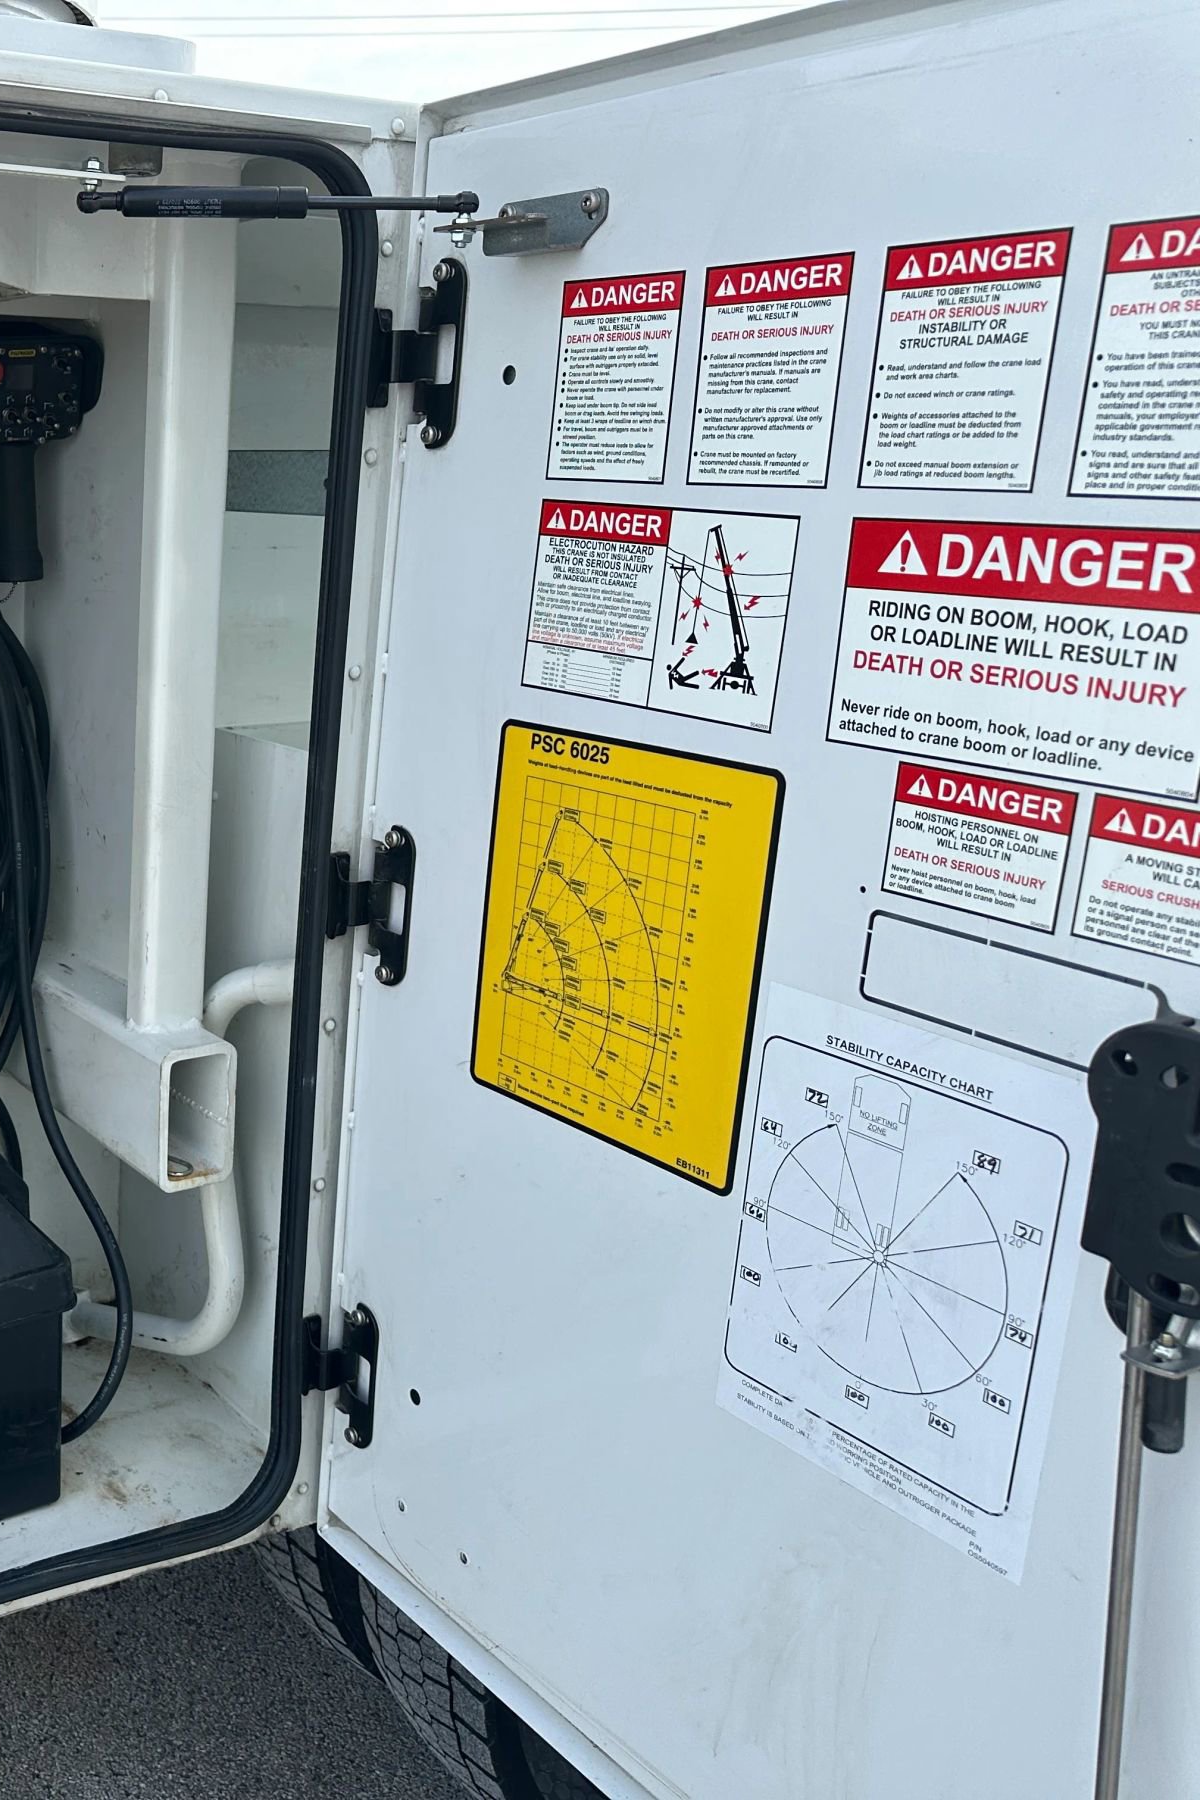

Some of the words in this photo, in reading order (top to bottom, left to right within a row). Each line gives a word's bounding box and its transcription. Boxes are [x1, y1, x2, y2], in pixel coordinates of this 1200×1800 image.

[927, 240, 1056, 277] DANGER
[740, 263, 842, 294] DANGER
[591, 280, 675, 307] DANGER
[901, 289, 934, 299] FAILURE
[936, 288, 946, 296] TO
[947, 286, 971, 295] OBEY
[972, 284, 989, 293] THE
[990, 280, 1041, 291] FOLLOWING
[937, 297, 956, 306] WILL
[958, 294, 990, 304] RESULT
[991, 293, 1000, 301] IN
[717, 305, 744, 315] FAILURE
[755, 303, 774, 312] OBEY
[775, 302, 789, 310] THE
[790, 298, 831, 309] FOLLOWING
[747, 313, 762, 321] WILL
[764, 311, 790, 320] RESULT
[791, 310, 798, 318] IN
[889, 309, 926, 322] DEATH
[928, 308, 946, 319] OR
[948, 303, 1000, 318] SERIOUS
[1003, 300, 1048, 314] INJURY
[573, 318, 595, 326] FAILURE
[604, 316, 620, 324] OBEY
[621, 315, 632, 323] THE
[632, 313, 666, 322] FOLLOWING
[612, 323, 634, 331] RESULT
[918, 319, 987, 334] INSTABILITY
[989, 318, 1007, 330] OR
[566, 334, 591, 344] DEATH
[592, 333, 604, 342] OR
[606, 331, 641, 342] SERIOUS
[642, 329, 672, 340] INJURY
[711, 330, 739, 341] DEATH
[741, 329, 755, 339] OR
[756, 326, 797, 338] SERIOUS
[799, 324, 834, 335] INJURY
[899, 335, 973, 349] STRUCTURAL
[976, 331, 1029, 345] DAMAGE
[569, 509, 662, 537] DANGER
[548, 537, 616, 552] ELECTROCUTION
[618, 543, 654, 556] HAZARD
[552, 546, 565, 555] THIS
[566, 548, 588, 557] CRANE
[588, 550, 595, 558] IS
[596, 551, 609, 559] NOT
[610, 553, 646, 563] INSULATED
[544, 554, 570, 565] DEATH
[571, 556, 584, 566] OR
[585, 558, 621, 570] SERIOUS
[622, 562, 653, 574] INJURY
[567, 566, 590, 575] RESULT
[590, 568, 608, 577] FROM
[609, 571, 638, 580] CONTACT
[936, 533, 1195, 593] DANGER
[562, 573, 599, 584] INADEQUATE
[600, 577, 637, 588] CLEARANCE
[868, 599, 930, 621] RIDING
[936, 605, 964, 624] ON
[970, 608, 1036, 633] BOOM,
[1044, 614, 1113, 640] HOOK,
[1122, 621, 1187, 644] LOAD
[870, 624, 896, 642] OR
[901, 627, 998, 653] LOADLINE
[1004, 637, 1053, 659] WILL
[1060, 642, 1148, 668] RESULT
[1154, 652, 1177, 672] IN
[853, 649, 923, 676] DEATH
[929, 658, 963, 681] OR
[969, 663, 1078, 695] SERIOUS
[1086, 676, 1186, 707] INJURY
[841, 698, 880, 715] Never
[883, 704, 909, 720] ride
[913, 712, 932, 724] on
[936, 711, 981, 733] boom,
[987, 719, 1029, 740] hook,
[1035, 725, 1071, 744] load
[1076, 735, 1094, 747] or
[1098, 738, 1130, 755] any
[1135, 741, 1194, 762] device
[530, 732, 565, 755] PSC
[570, 740, 610, 764] 6025
[838, 718, 897, 738] attached
[900, 727, 914, 740] to
[918, 732, 958, 747] crane
[962, 735, 1006, 755] boom
[1011, 746, 1028, 758] or
[1032, 746, 1101, 770] loadline.
[937, 778, 1063, 824] DANGER
[914, 810, 958, 827] HOISTING
[960, 819, 1020, 840] PERSONNEL
[1023, 832, 1038, 843] ON
[895, 817, 925, 832] BOOM,
[927, 824, 957, 840] HOOK,
[959, 831, 987, 845] LOAD
[989, 837, 1004, 849] OR
[1006, 841, 1058, 860] LOADLINE
[936, 837, 958, 850] WILL
[960, 842, 999, 858] RESULT
[1000, 851, 1011, 862] IN
[893, 846, 929, 863] DEATH
[931, 855, 947, 867] OR
[950, 859, 1000, 879] SERIOUS
[1002, 871, 1046, 890] INJURY
[1124, 853, 1133, 863] A
[1135, 855, 1183, 873] MOVING
[1101, 879, 1153, 899] SERIOUS
[1152, 871, 1180, 886] WILL
[826, 1034, 883, 1061] STABILITY
[885, 1055, 946, 1083] CAPACITY
[949, 1077, 993, 1100] CHART
[859, 1109, 870, 1119] NO
[871, 1114, 898, 1130] LIFTING
[867, 1122, 886, 1136] ZONE
[675, 1157, 709, 1179] EB11311
